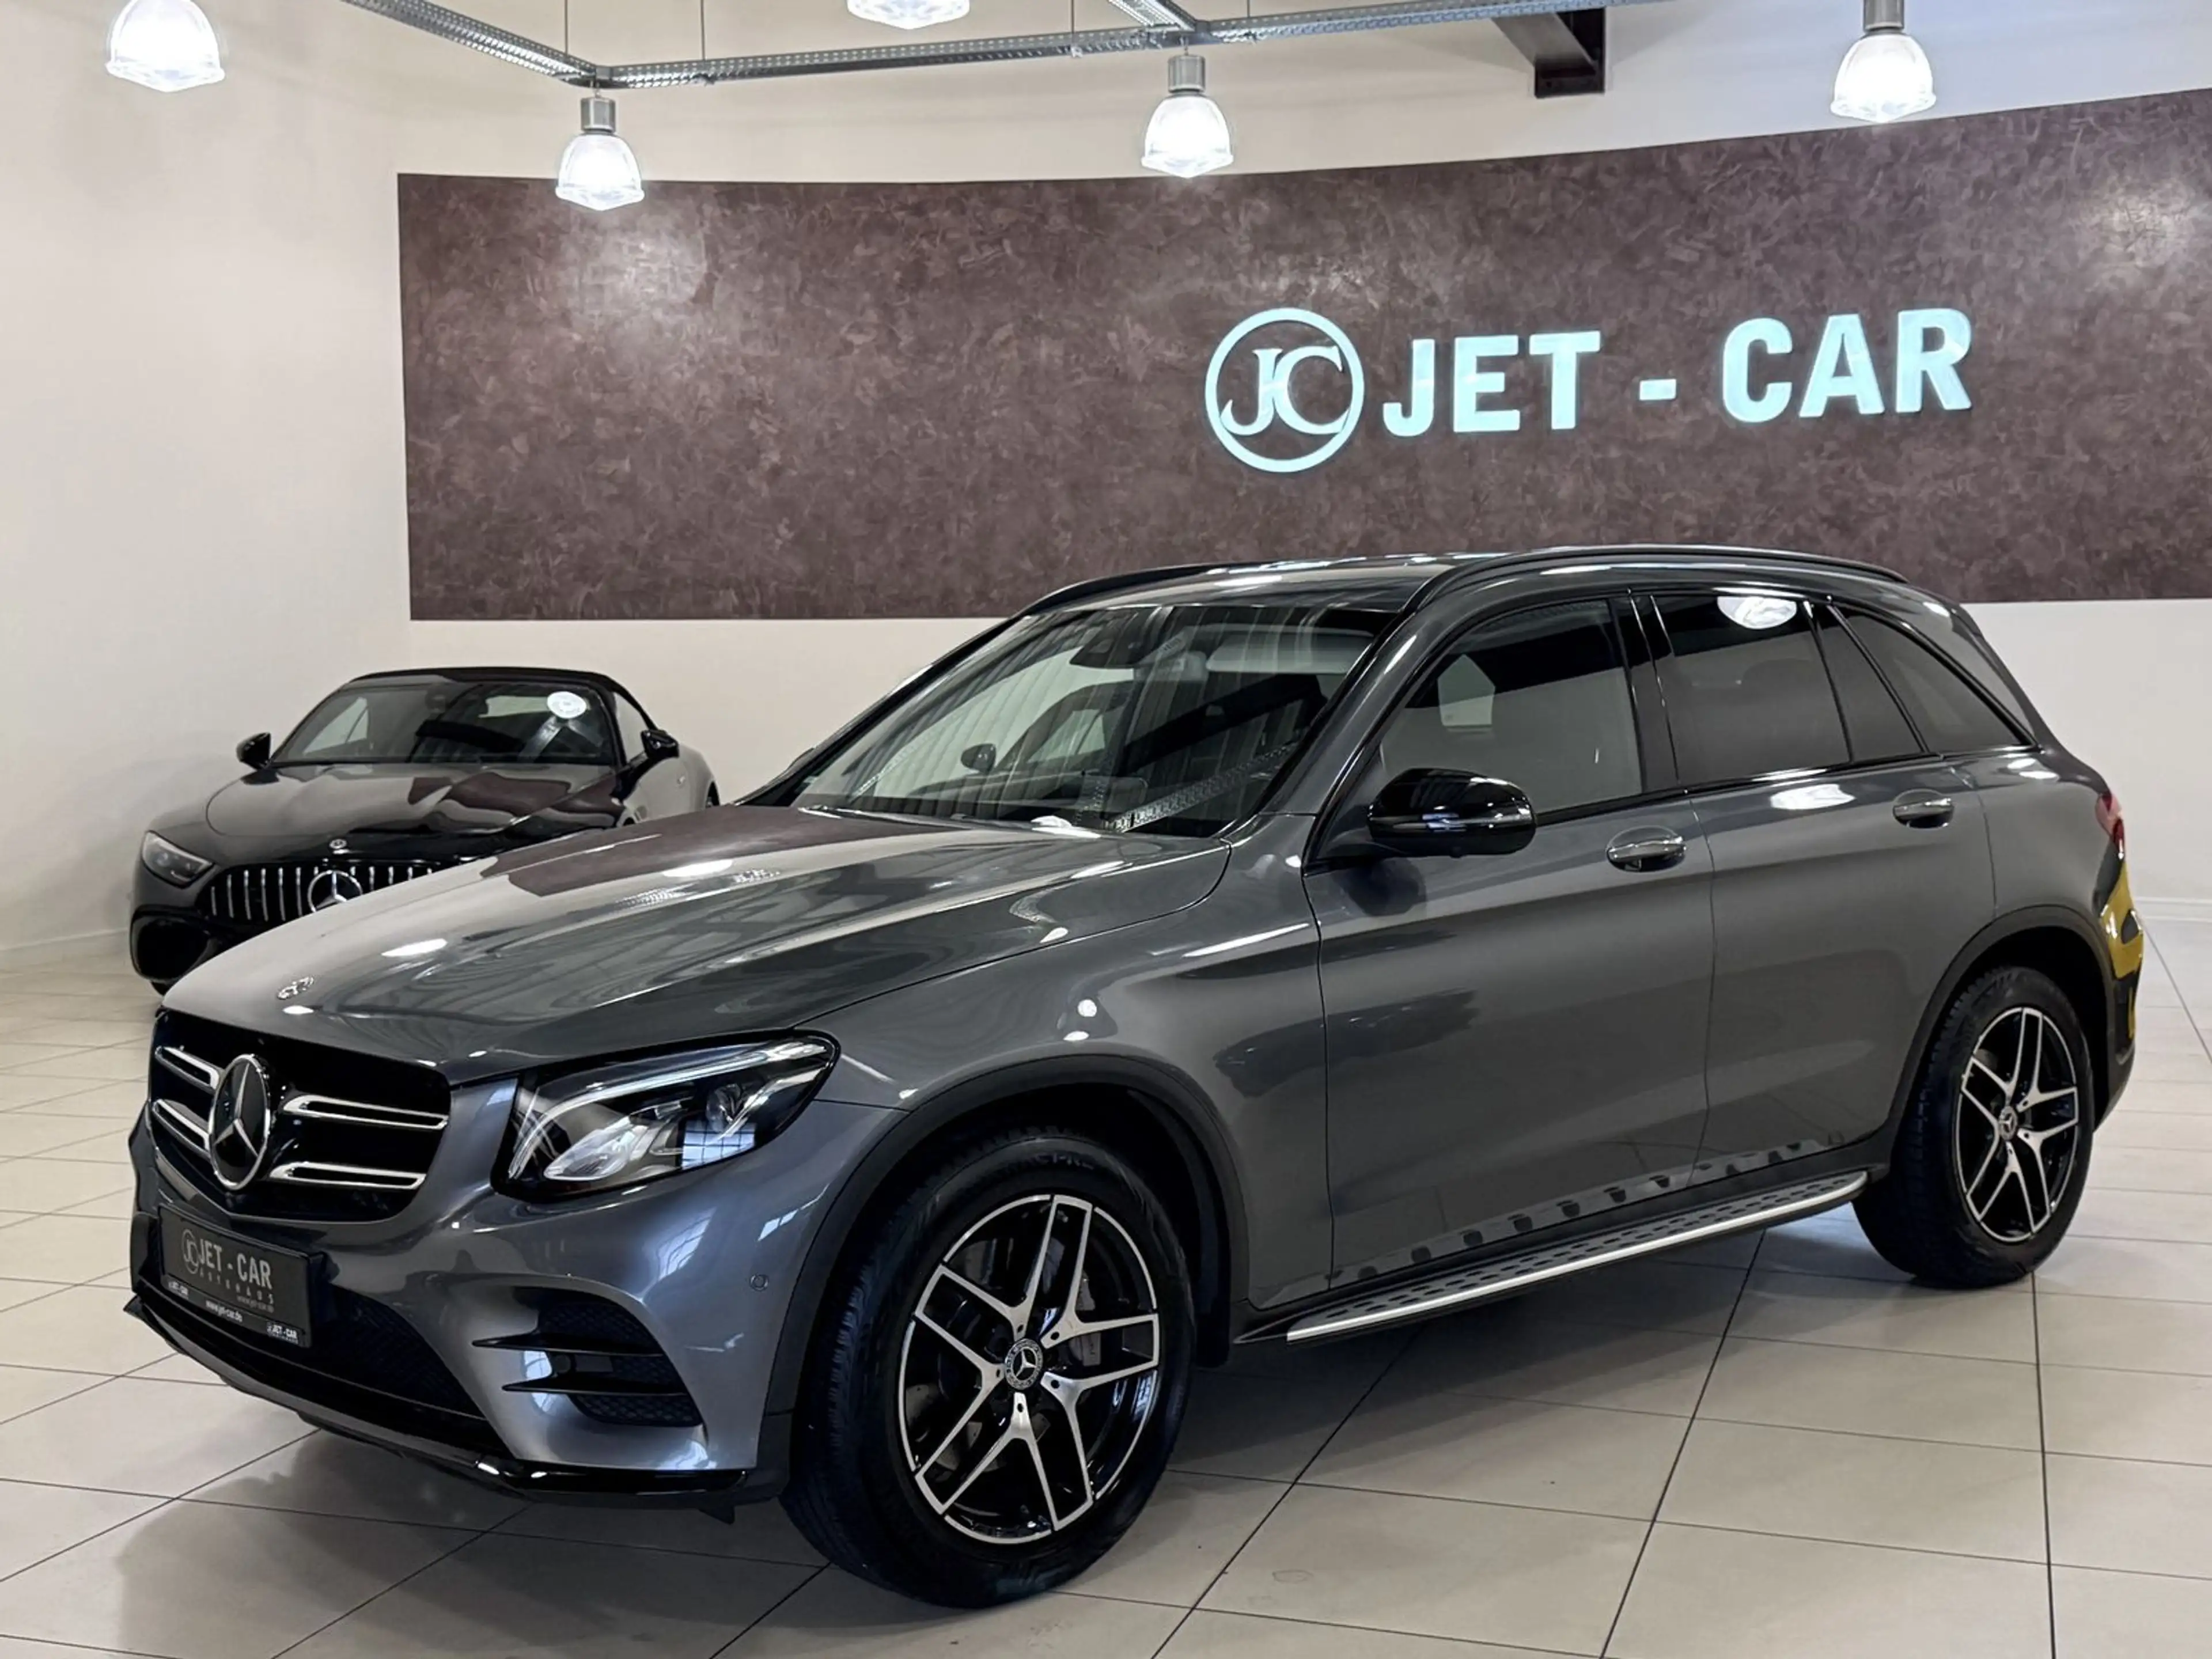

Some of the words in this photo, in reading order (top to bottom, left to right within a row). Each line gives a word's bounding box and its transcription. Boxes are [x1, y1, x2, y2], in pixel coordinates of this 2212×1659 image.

[1382, 331, 1601, 437] JET
[1639, 378, 1677, 401] -
[1722, 308, 1972, 423] CAR
[198, 1238, 222, 1272] JET
[237, 1252, 272, 1290] CAR
